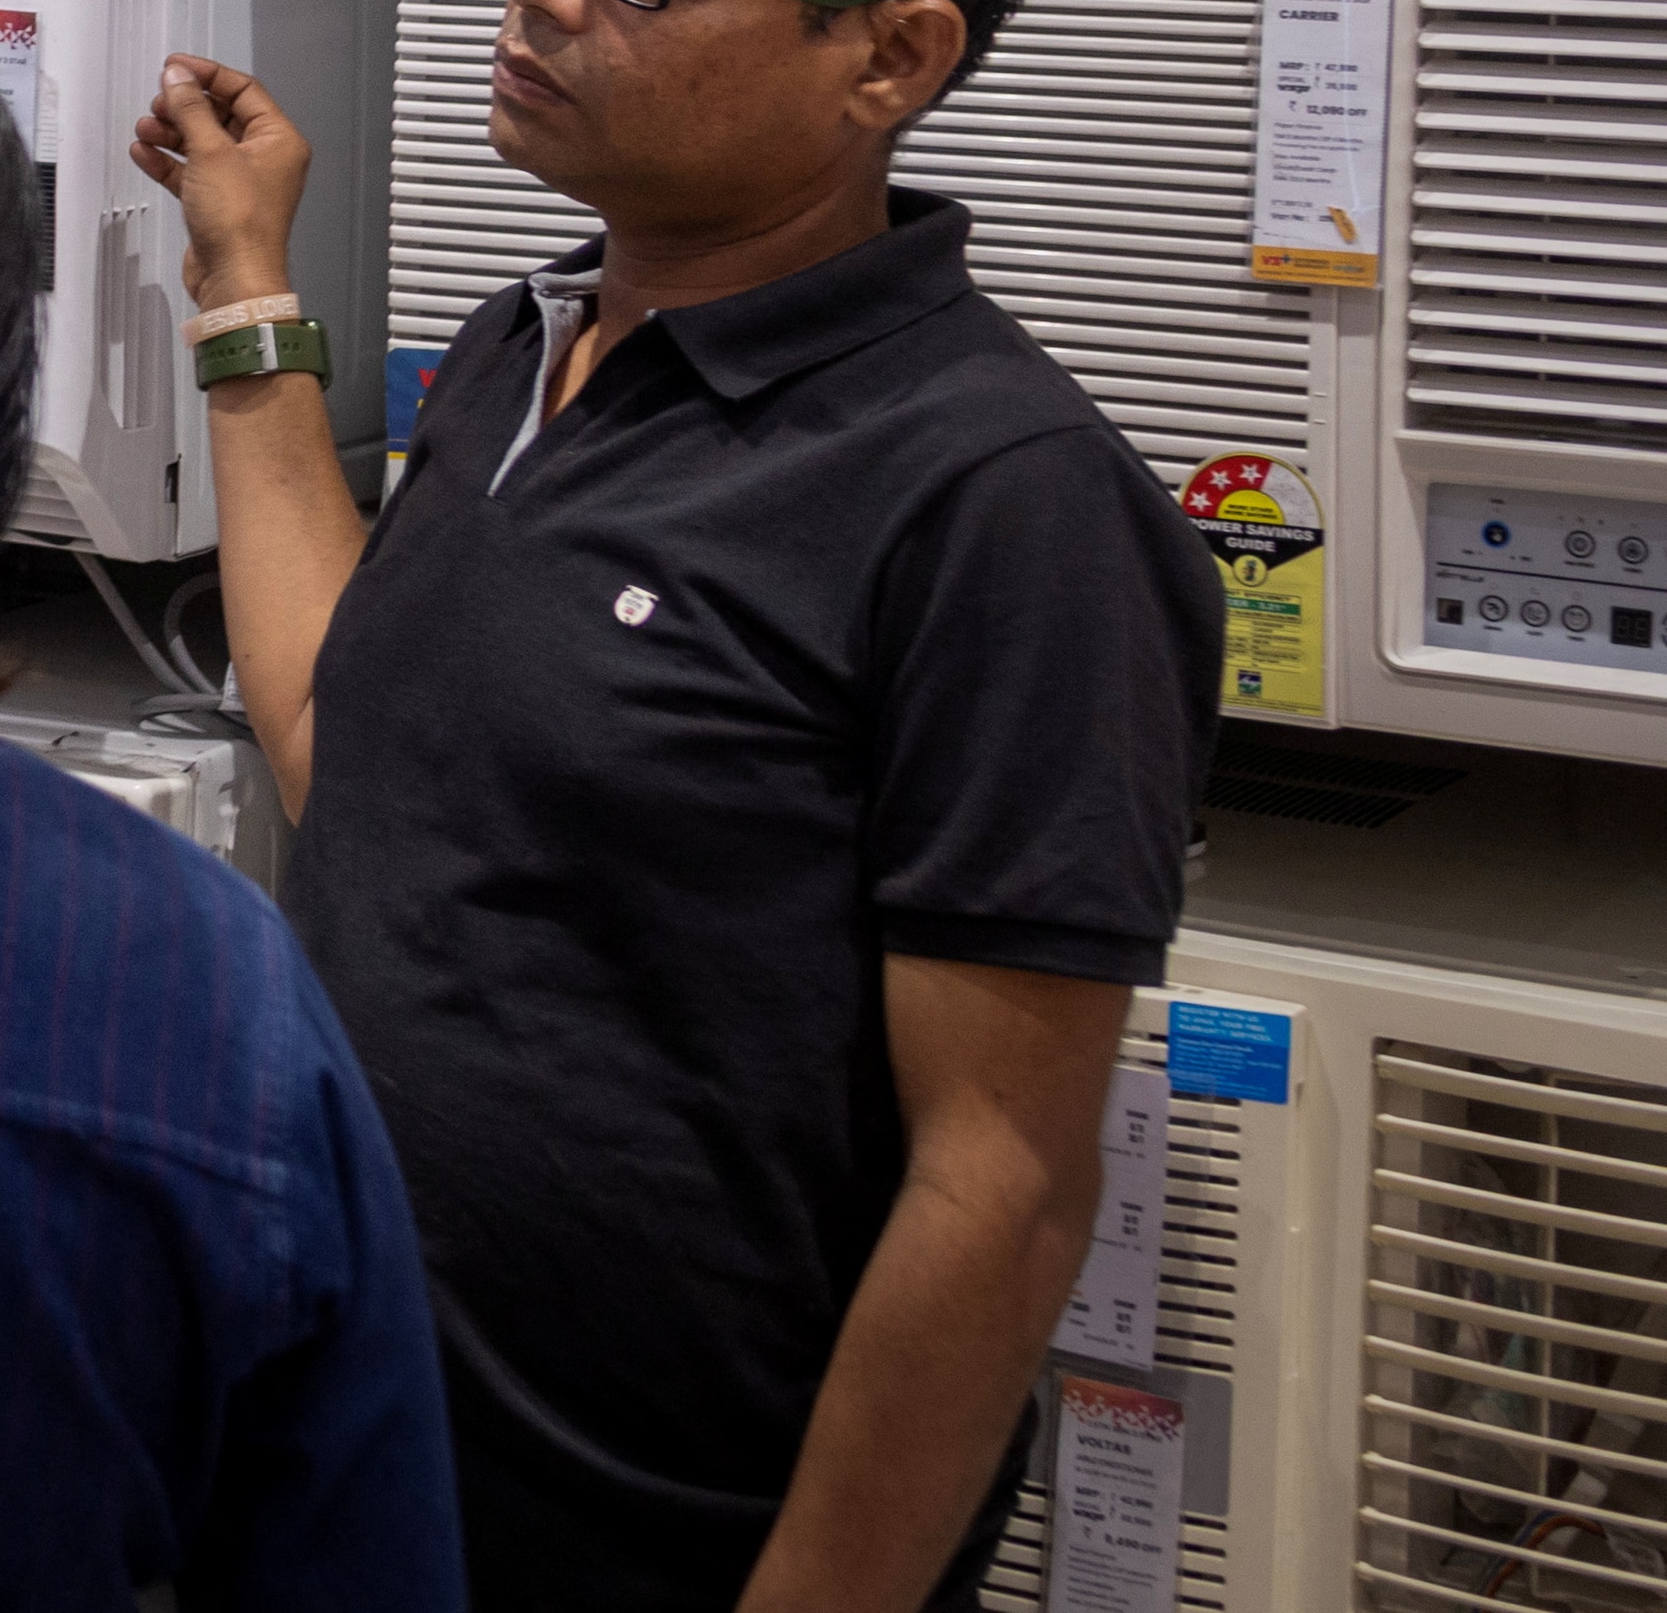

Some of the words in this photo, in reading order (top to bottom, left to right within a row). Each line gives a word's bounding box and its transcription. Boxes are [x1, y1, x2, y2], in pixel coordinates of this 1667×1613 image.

[1279, 9, 1339, 21] CARRIER
[1347, 108, 1368, 117] OFF
[1246, 524, 1315, 542] SAVINGS
[1225, 536, 1276, 553] GUIDE
[1077, 1434, 1132, 1456] VOLTAS
